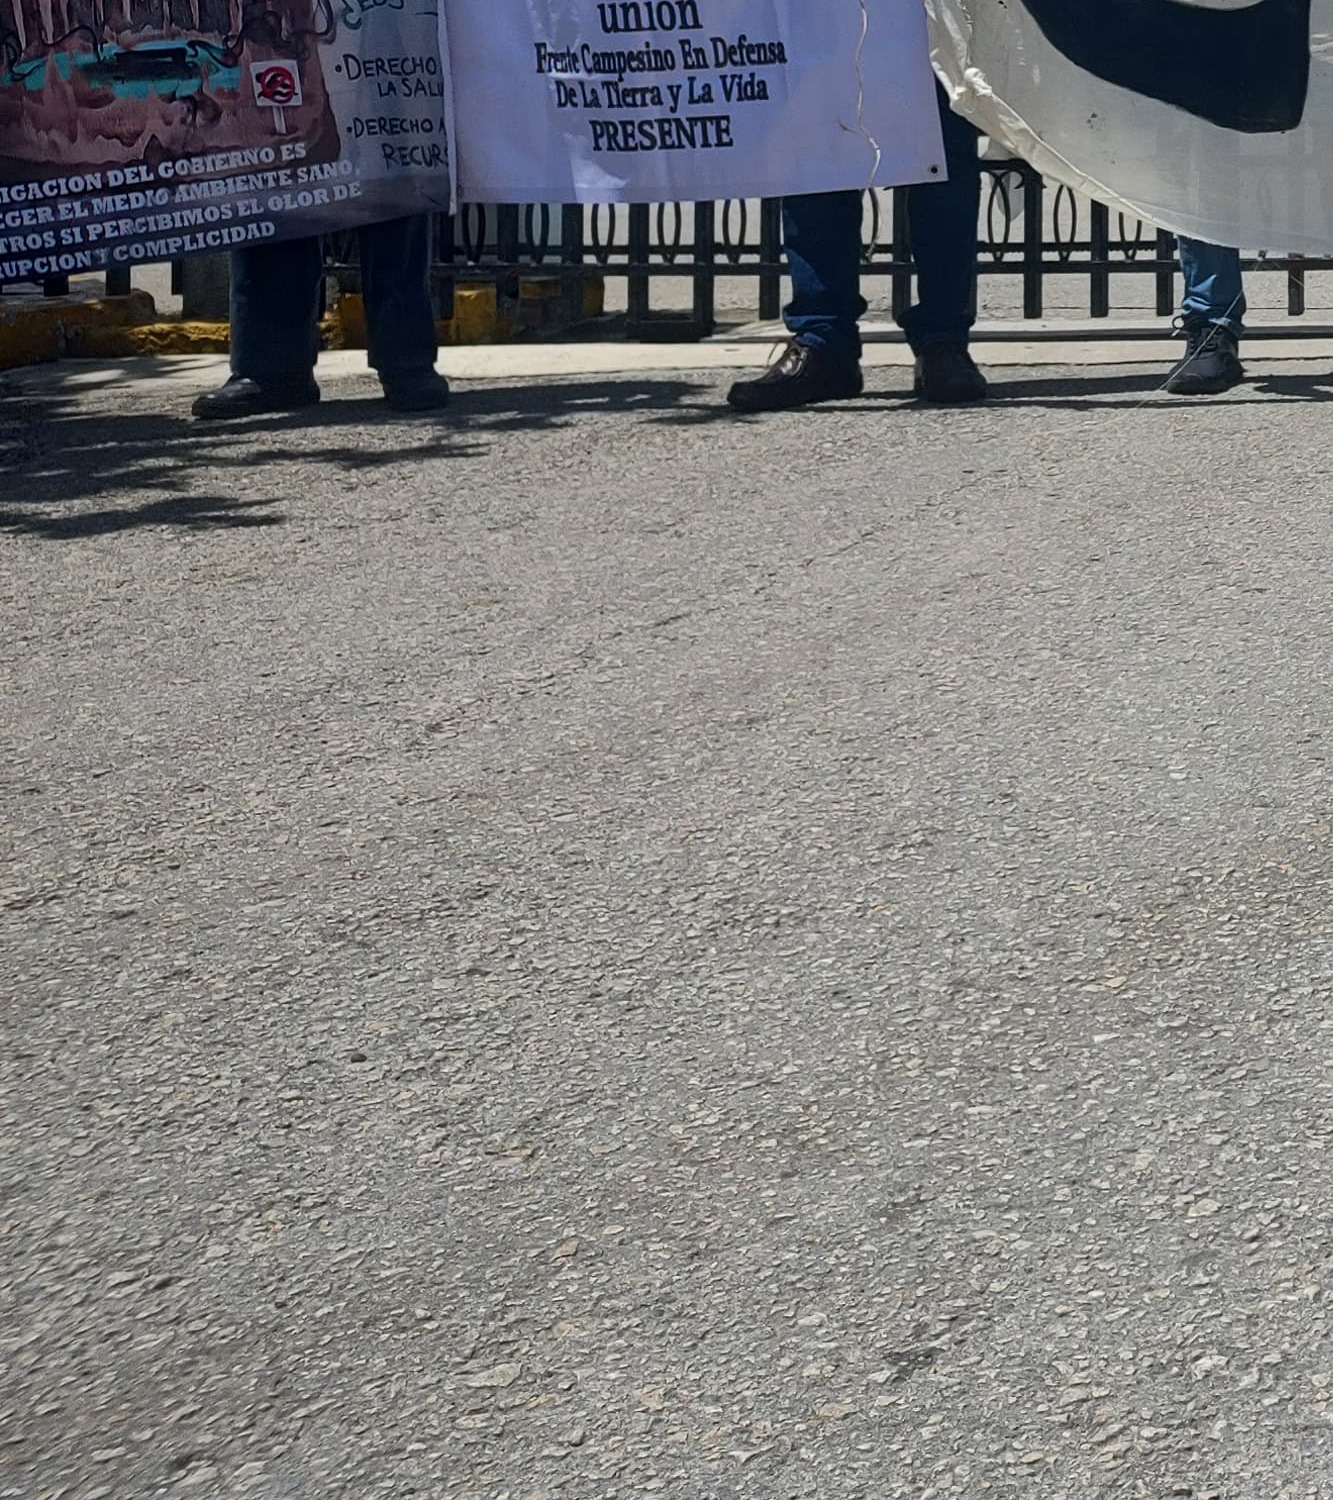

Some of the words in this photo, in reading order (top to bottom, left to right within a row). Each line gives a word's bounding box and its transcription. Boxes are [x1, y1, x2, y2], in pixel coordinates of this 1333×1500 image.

[343, 54, 437, 81] DERECHO
[581, 41, 676, 81] Campesino
[678, 38, 709, 70] En
[710, 34, 788, 69] Defensa
[377, 81, 397, 97] LA
[556, 80, 578, 108] De
[579, 80, 601, 108] La
[602, 79, 663, 108] Tierra
[667, 84, 682, 113] y
[687, 76, 714, 104] La
[720, 72, 769, 102] Vida
[353, 115, 433, 138] DERECHO
[589, 115, 734, 152] PRESENTE
[0, 171, 102, 204] IGACION
[107, 165, 154, 187] DEL
[158, 146, 275, 178] GOBIERNO
[280, 143, 307, 161] ES
[58, 201, 89, 221] EL
[92, 187, 169, 216] MEDIO
[174, 168, 292, 203] AMBIENTE
[60, 226, 83, 245] SI
[87, 203, 232, 242] PERCIBIMOS
[236, 197, 264, 218] EL
[267, 187, 330, 211] OLOR
[333, 180, 362, 201] DE
[113, 221, 276, 261] COMPLICIDAD
